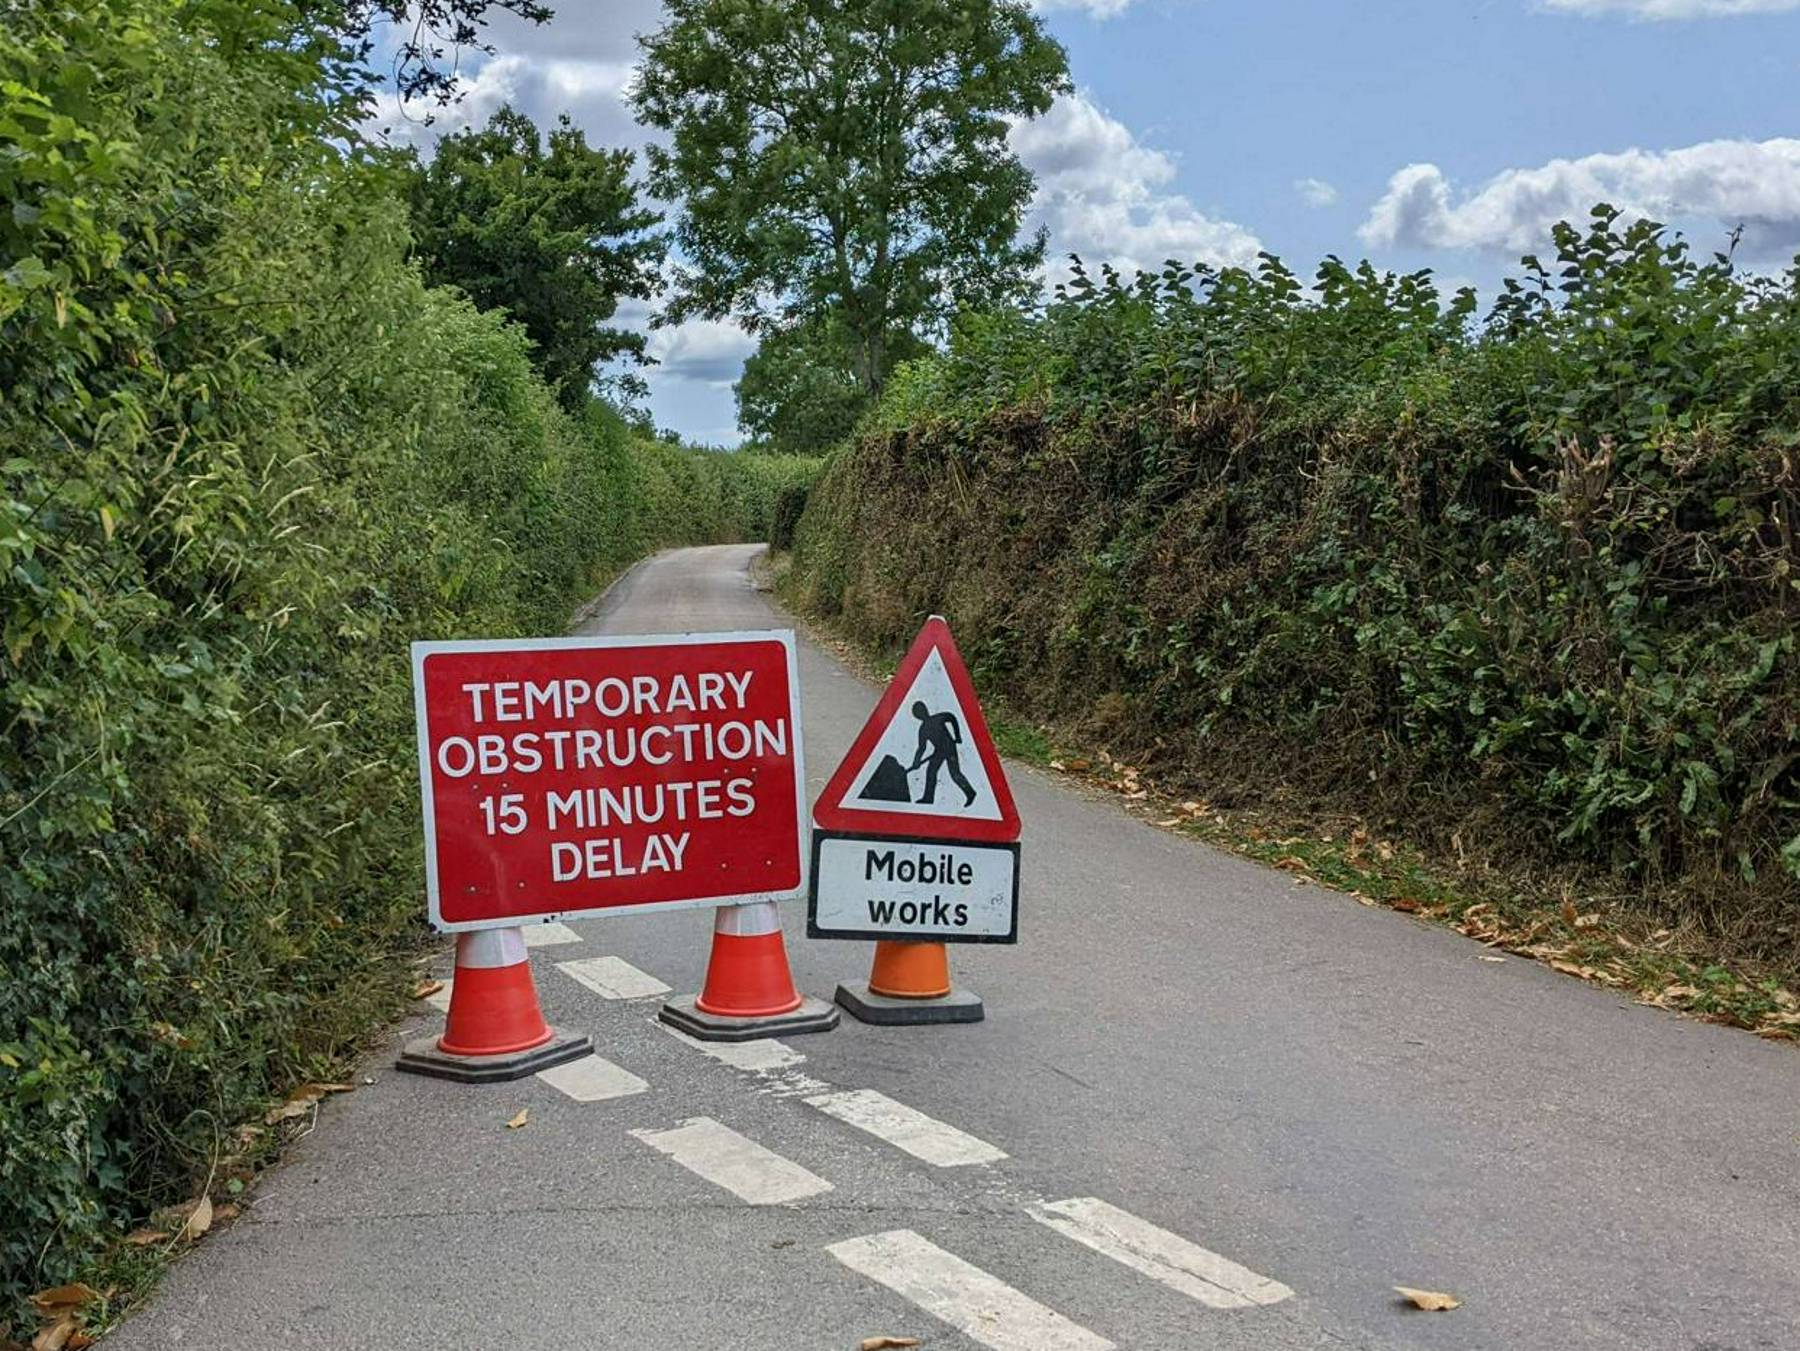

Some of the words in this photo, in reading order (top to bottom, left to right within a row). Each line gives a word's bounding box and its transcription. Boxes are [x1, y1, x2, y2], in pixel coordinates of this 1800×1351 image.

[462, 670, 755, 723] TEMPORARY
[437, 718, 787, 779] OBSTRUCTION
[478, 793, 527, 836] 15
[546, 778, 756, 831] MINUTES
[550, 832, 691, 883] DELAY
[865, 849, 973, 885] Mobile
[868, 895, 968, 927] works
